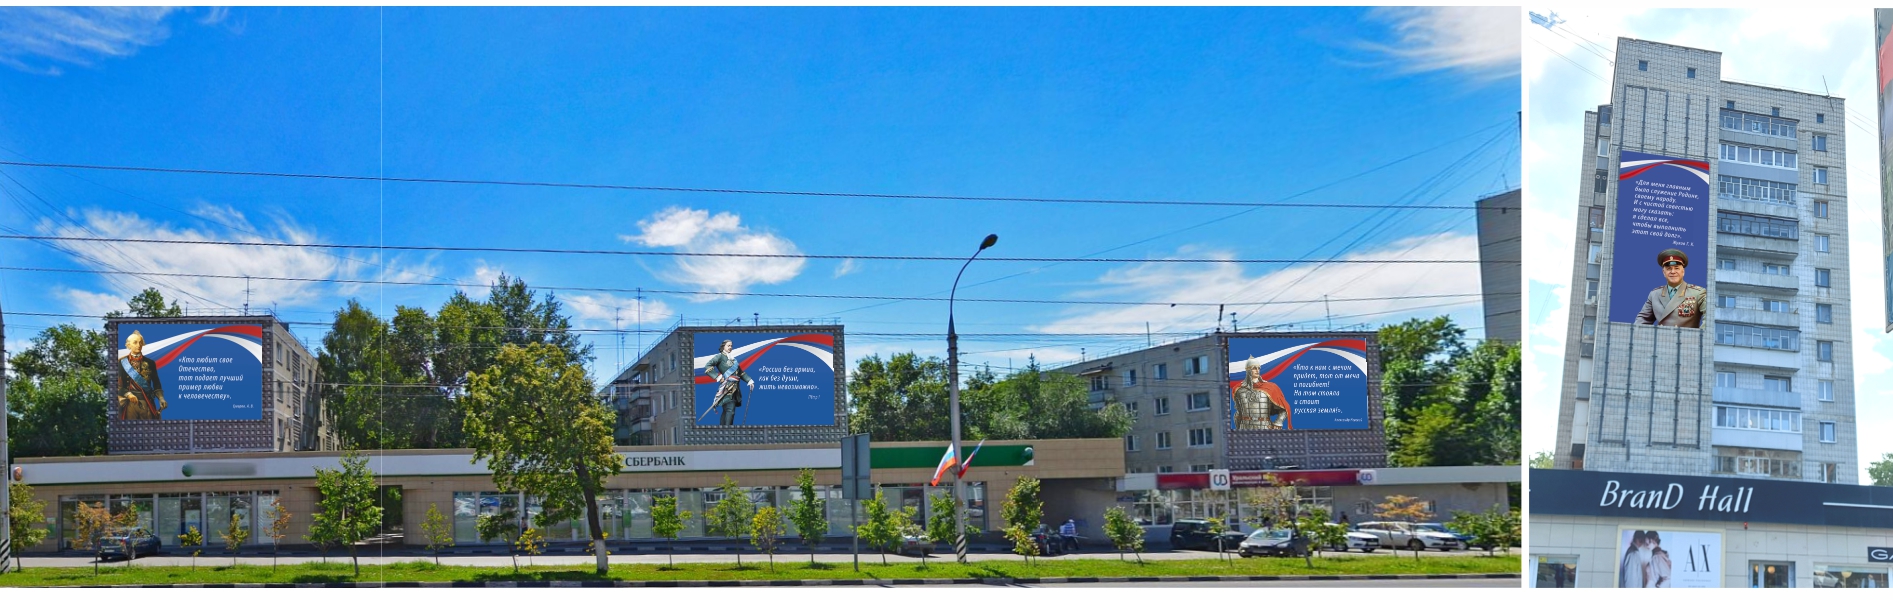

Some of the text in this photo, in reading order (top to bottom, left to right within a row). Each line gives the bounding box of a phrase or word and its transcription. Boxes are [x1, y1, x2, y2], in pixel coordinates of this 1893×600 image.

[1678, 191, 1699, 200] Родине,
[219, 374, 244, 382] лучший
[625, 456, 686, 466] СБЕРБАНК
[1600, 480, 1753, 513] BranD Hall
